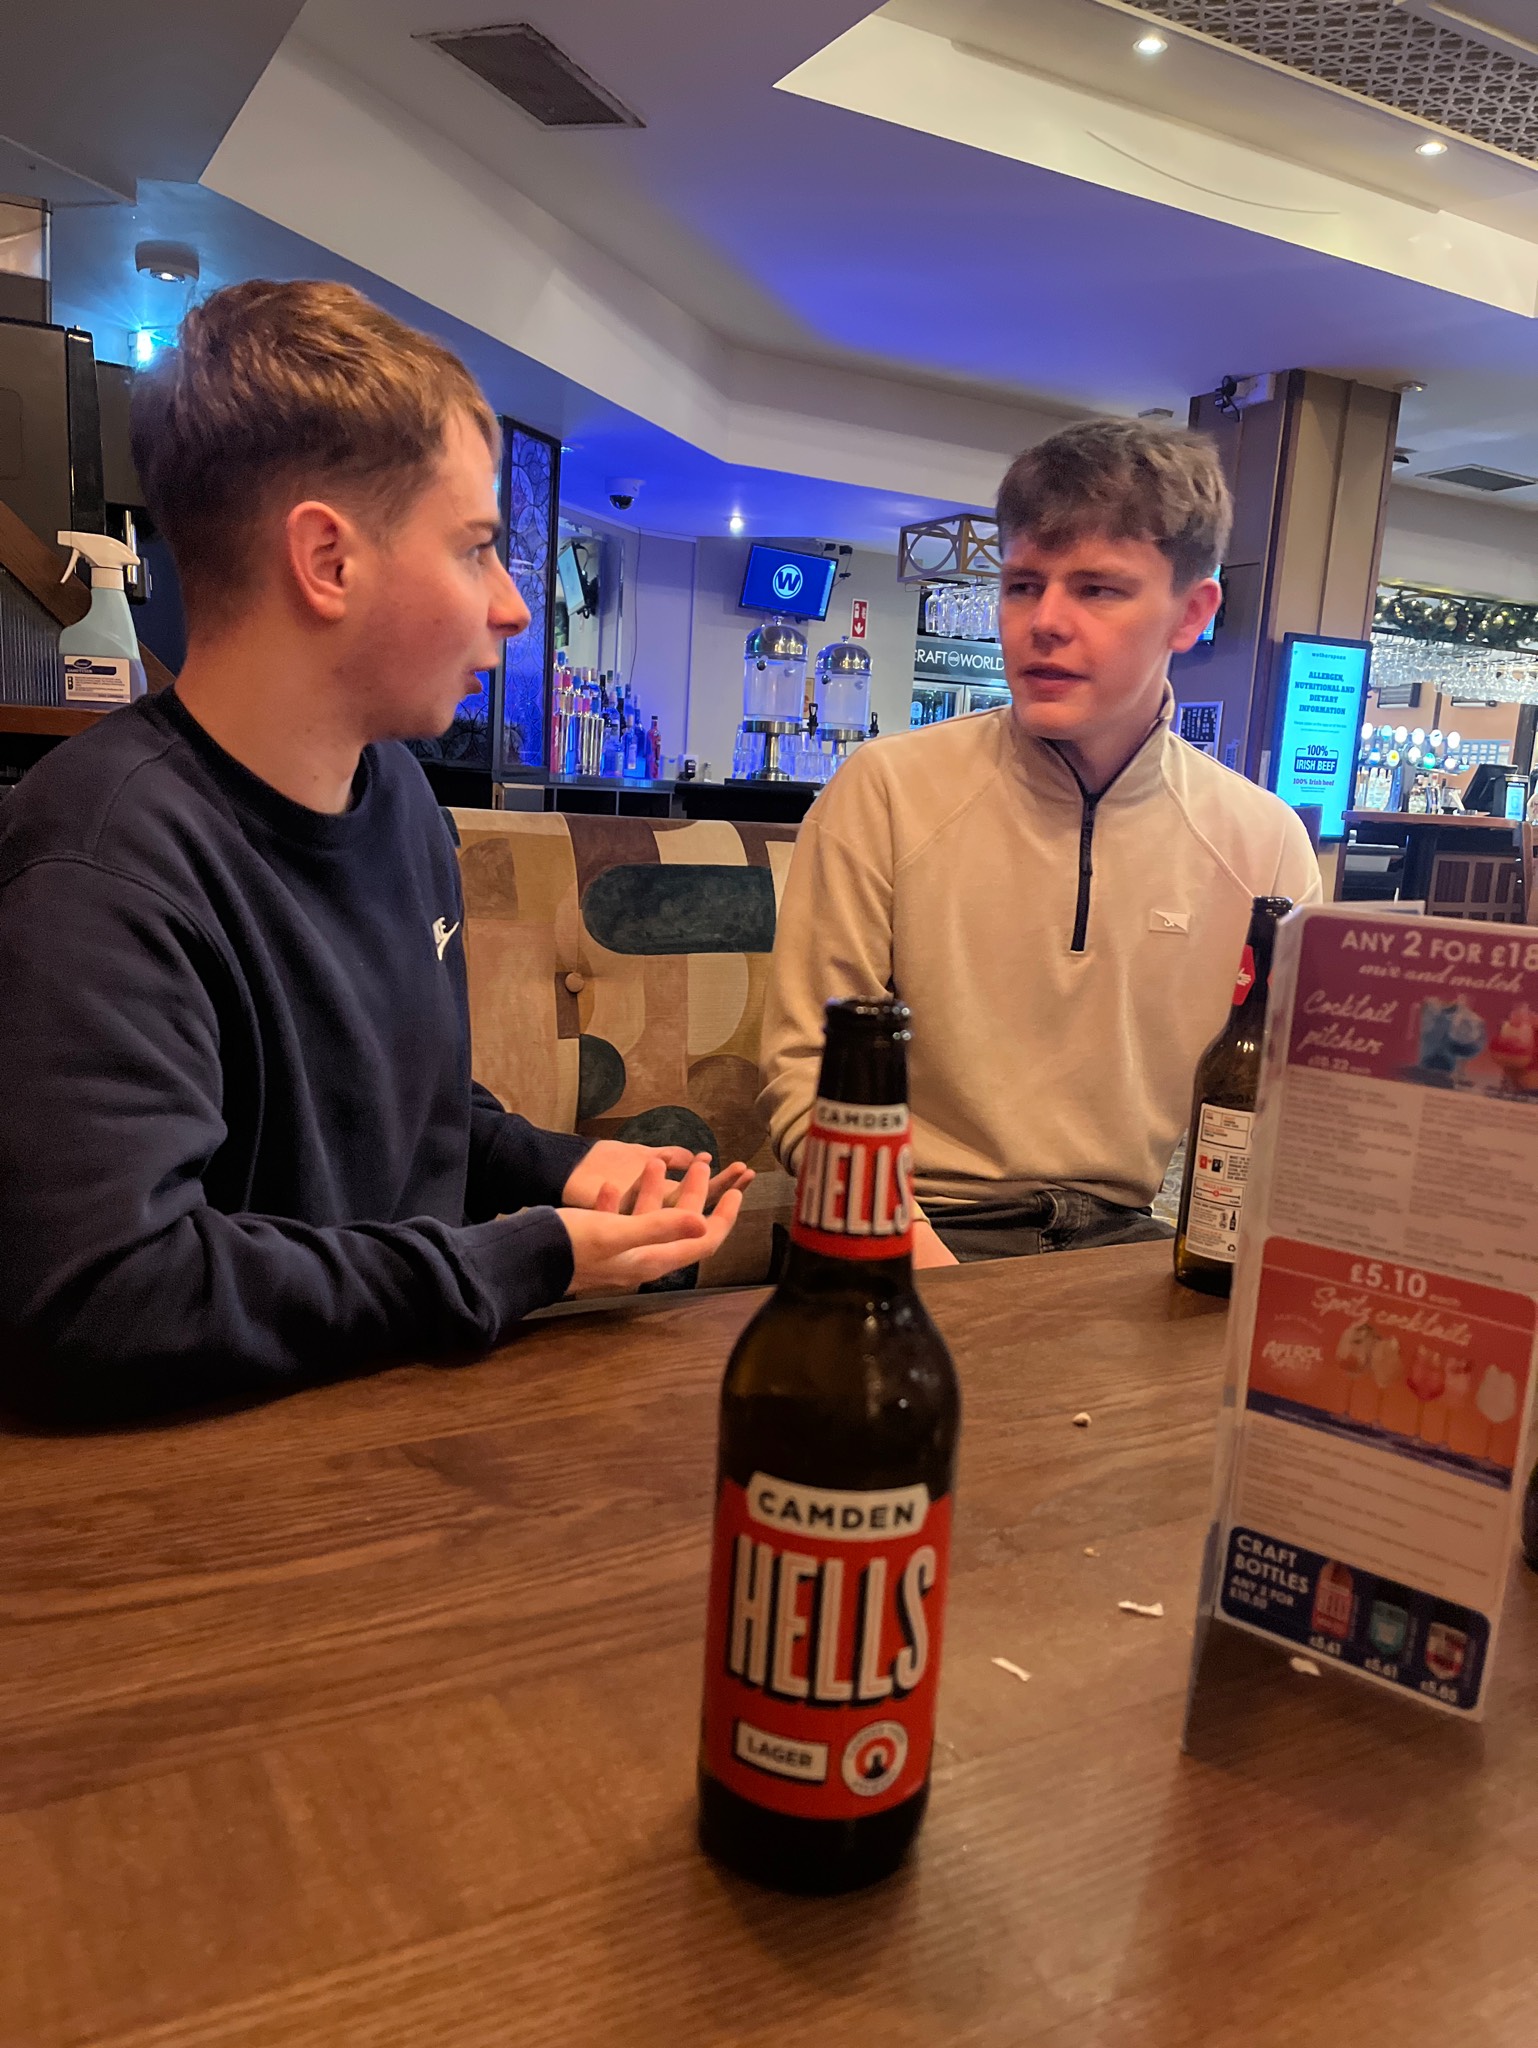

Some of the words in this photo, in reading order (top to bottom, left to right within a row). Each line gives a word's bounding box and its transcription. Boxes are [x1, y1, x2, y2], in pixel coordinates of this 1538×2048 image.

[960, 653, 1004, 671] WORLD
[1308, 671, 1344, 682] ALLERGEN,
[1295, 681, 1340, 692] NUTRITIONAL
[1309, 694, 1338, 703] DIETARY
[1299, 704, 1346, 715] INFORMATION
[1296, 759, 1316, 771] IRISH
[1317, 760, 1335, 771] BEEF
[1307, 745, 1328, 756] 100%
[1309, 778, 1322, 786] Irish
[1341, 930, 1395, 953] ANY
[1402, 930, 1422, 958] 2
[1430, 938, 1482, 964] FOR
[1403, 965, 1455, 984] and
[1449, 972, 1524, 993] match
[1303, 989, 1399, 1024] Cocktail
[1296, 1022, 1384, 1055] pitchers
[818, 1105, 903, 1128] CAMDEN
[797, 1137, 913, 1236] HELLS
[1350, 1262, 1428, 1299] £5.10
[1375, 1309, 1472, 1347] cocktails
[757, 1490, 915, 1530] CAMDEN
[1237, 1534, 1297, 1567] CRAFT
[1234, 1553, 1308, 1594] BOTTLES
[728, 1534, 937, 1706] HELLS
[747, 1736, 813, 1767] LAGER
